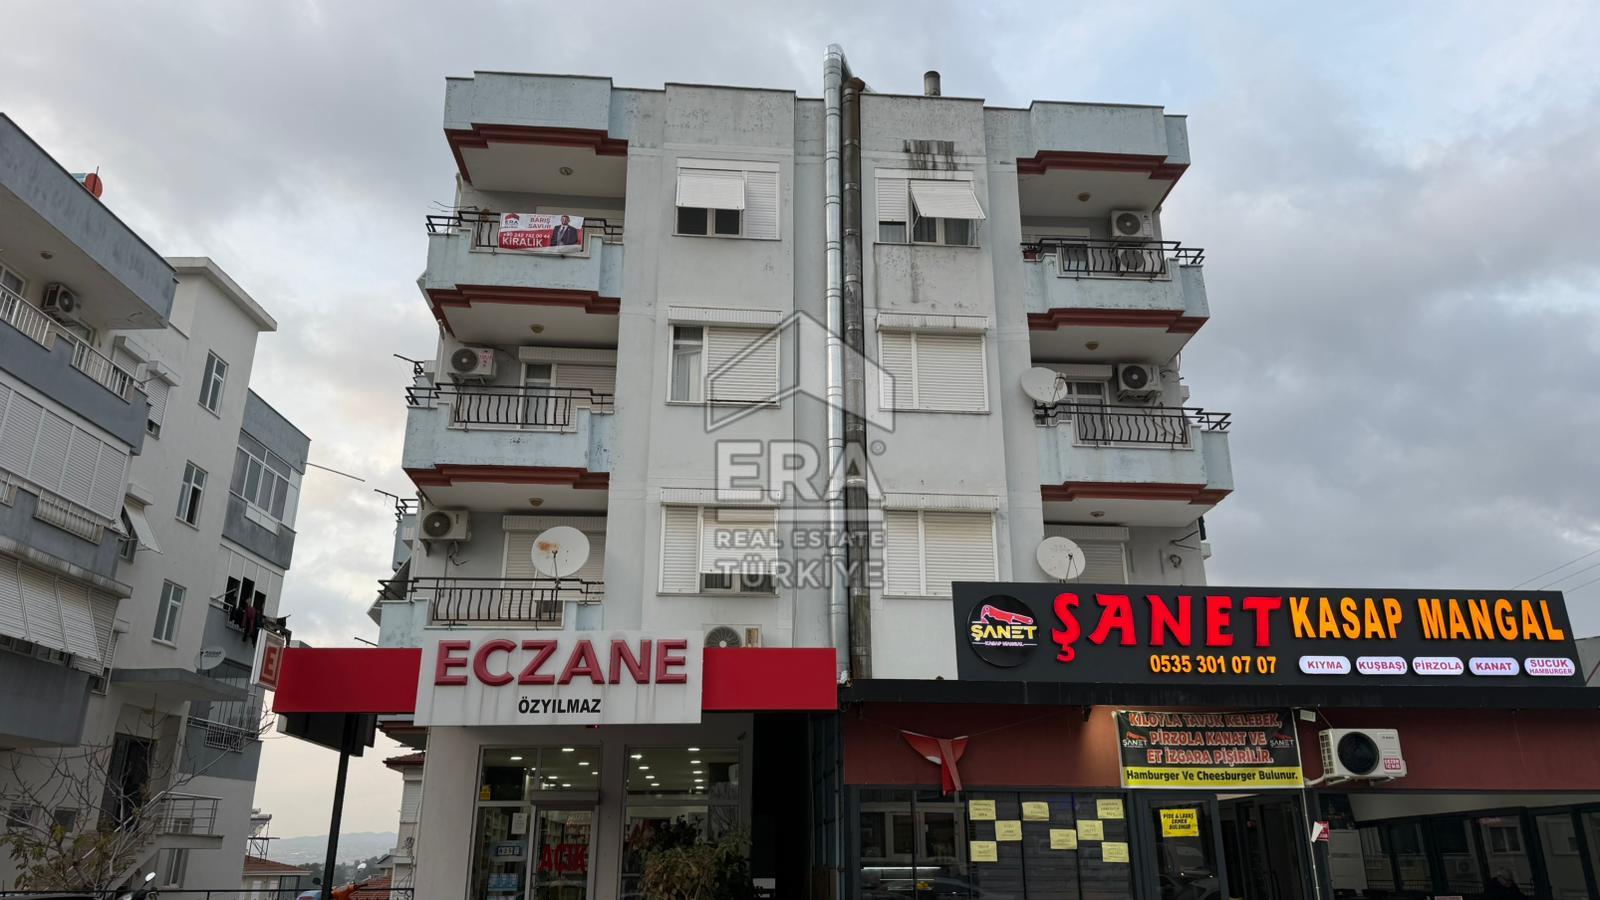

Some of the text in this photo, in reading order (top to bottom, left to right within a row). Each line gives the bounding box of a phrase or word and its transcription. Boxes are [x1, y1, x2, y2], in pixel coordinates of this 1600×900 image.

[1289, 596, 1565, 641] KASAP MANGAL
[971, 624, 1037, 641] ŞANET
[1051, 592, 1282, 662] ŞANET
[434, 639, 688, 686] ECZANE
[1150, 654, 1277, 674] 0535 301 07 07
[1307, 660, 1343, 670] KIYMA
[1358, 661, 1406, 670] KUŞBAŞI
[1414, 660, 1462, 670] PİRZOLA
[1475, 662, 1512, 671] KANAT
[1529, 659, 1569, 668] SUCUK
[518, 696, 601, 714] ÖZYILMAZ
[1185, 713, 1224, 727] TAVUK
[1122, 739, 1148, 748] ŞANET
[1150, 728, 1267, 746] PİRZOLA KANAT VE
[1147, 749, 1162, 764] ET
[1127, 770, 1298, 782] Hamburger Ve Cheesburger Bulunur.
